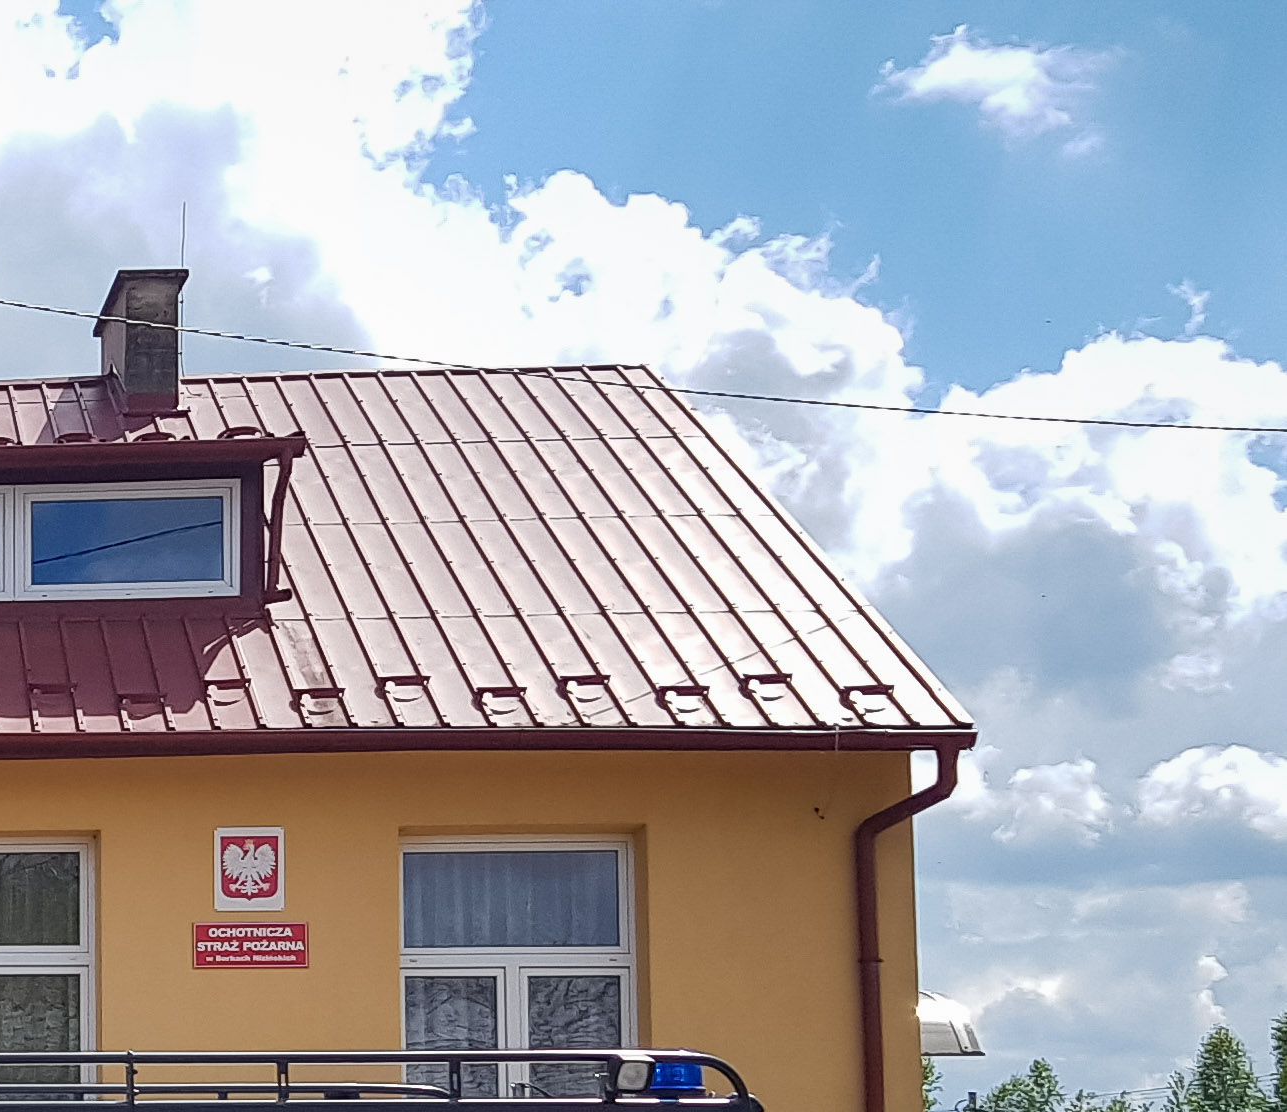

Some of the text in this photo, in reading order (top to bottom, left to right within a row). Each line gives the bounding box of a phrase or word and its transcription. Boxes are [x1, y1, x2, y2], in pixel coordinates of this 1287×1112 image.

[208, 928, 292, 937] OCHOTNICZA
[197, 940, 304, 951] STRAŻ POŻARNA
